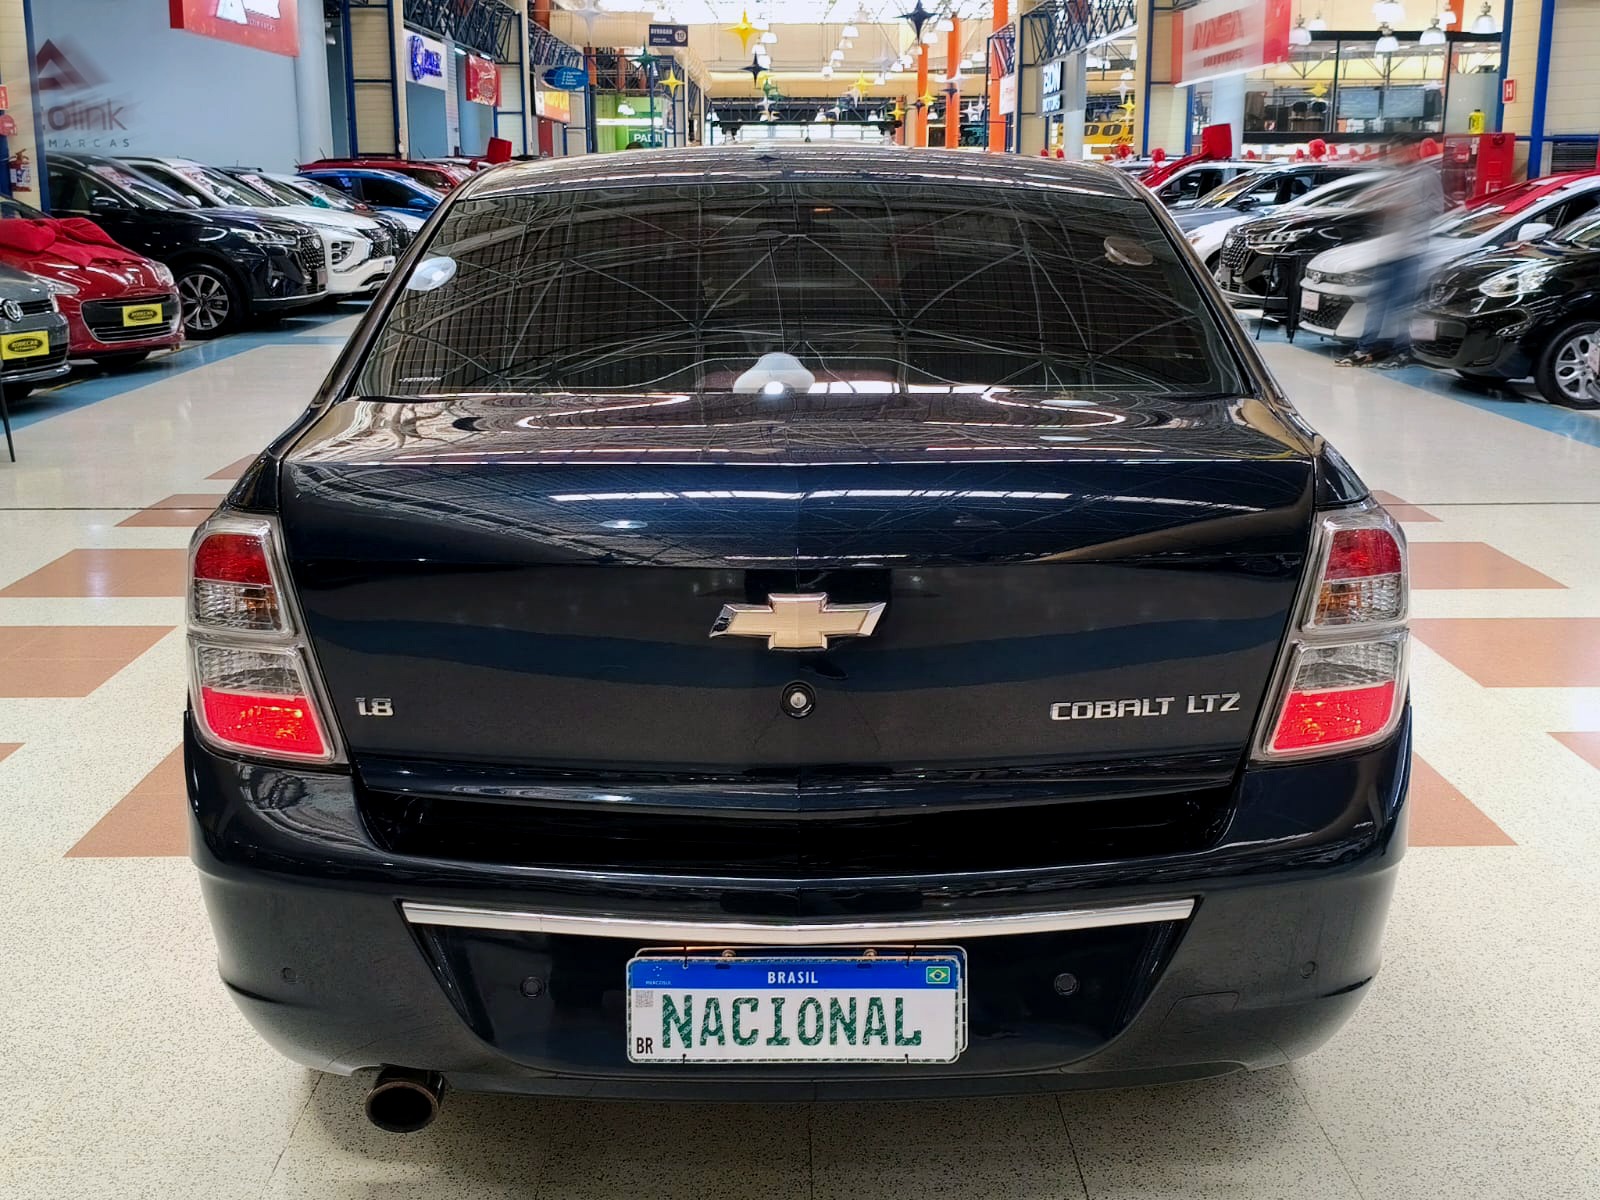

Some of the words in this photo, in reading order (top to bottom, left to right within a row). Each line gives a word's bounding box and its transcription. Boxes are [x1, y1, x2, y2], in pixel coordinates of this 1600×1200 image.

[48, 138, 131, 149] MARCAS
[354, 697, 395, 717] 1.8
[1050, 696, 1176, 721] COBALT
[1186, 691, 1241, 714] LTZ
[767, 970, 819, 984] BRASIL
[662, 994, 923, 1049] NACIONAL
[636, 1036, 654, 1055] BR
